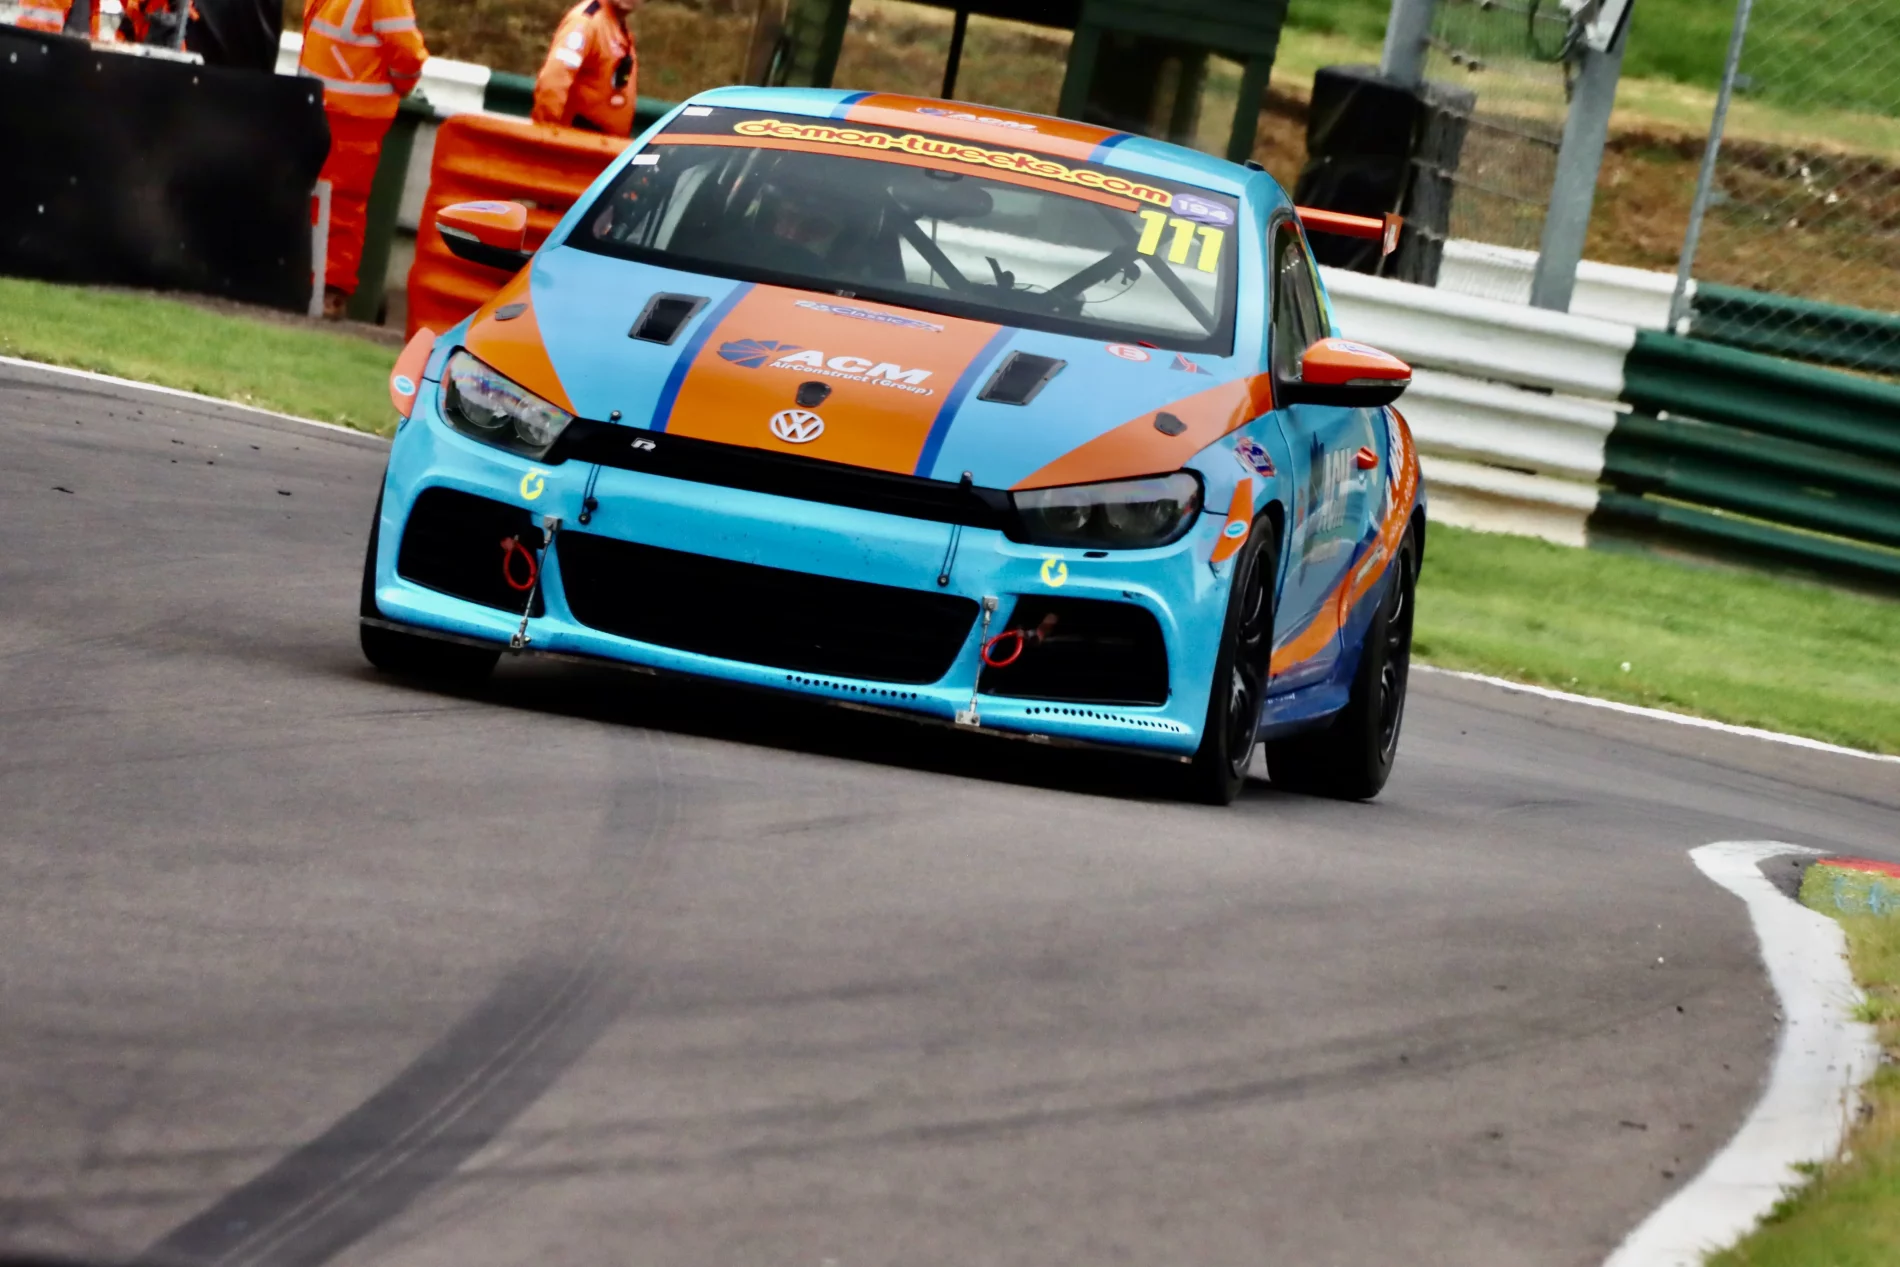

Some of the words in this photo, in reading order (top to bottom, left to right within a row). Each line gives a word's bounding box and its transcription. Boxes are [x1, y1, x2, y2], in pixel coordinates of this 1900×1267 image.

[735, 120, 1172, 207] demon-tweeks.com
[1137, 210, 1224, 273] 111
[769, 361, 869, 382] AirConstruct
[871, 378, 934, 396] (Group)
[778, 350, 933, 385] ACM
[770, 409, 824, 443] VW
[631, 437, 656, 452] R
